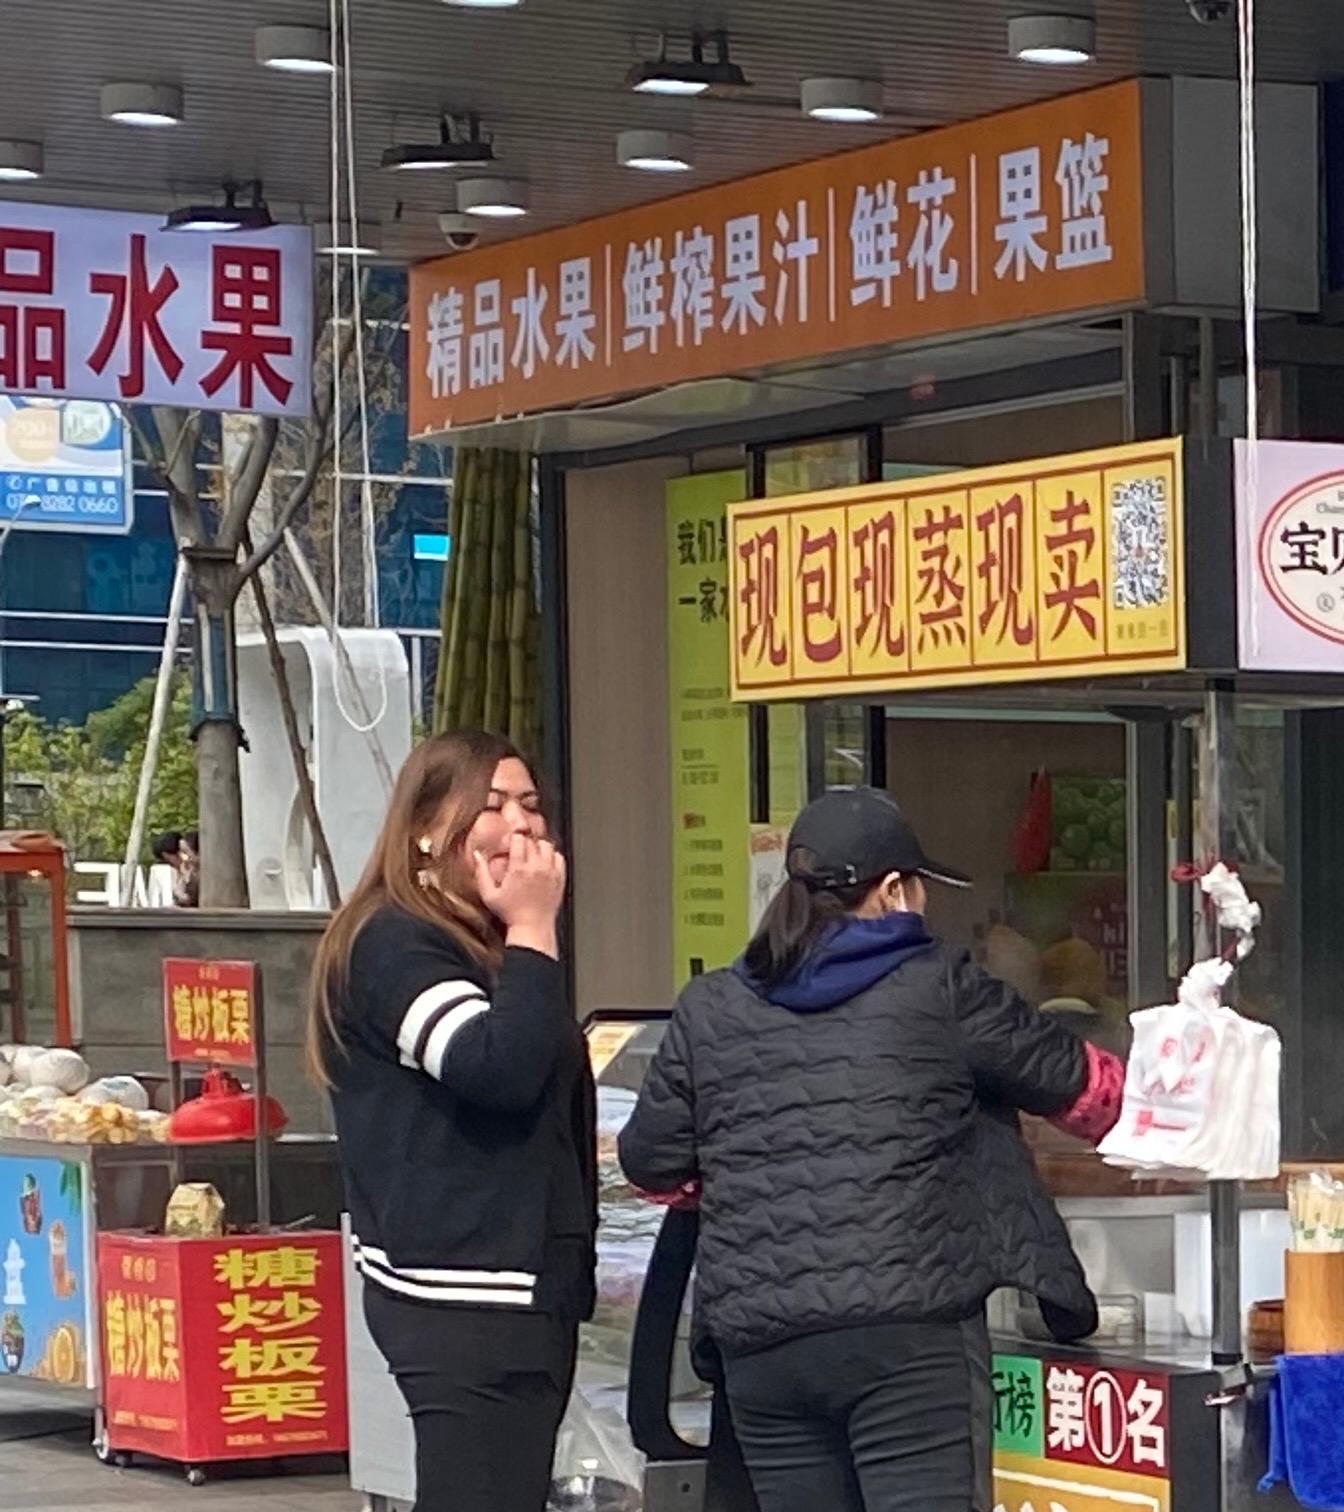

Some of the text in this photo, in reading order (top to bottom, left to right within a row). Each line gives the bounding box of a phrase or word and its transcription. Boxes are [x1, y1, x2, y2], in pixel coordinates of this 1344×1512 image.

[426, 132, 1113, 399] 精品水果 鲜榨果汁 鲜花 果篮
[739, 489, 1100, 667] 现包现蒸现卖
[173, 984, 250, 1046] 糖炒板栗
[106, 1289, 180, 1384] 糖炒板栗
[213, 1246, 327, 1423] 糖炒板栗
